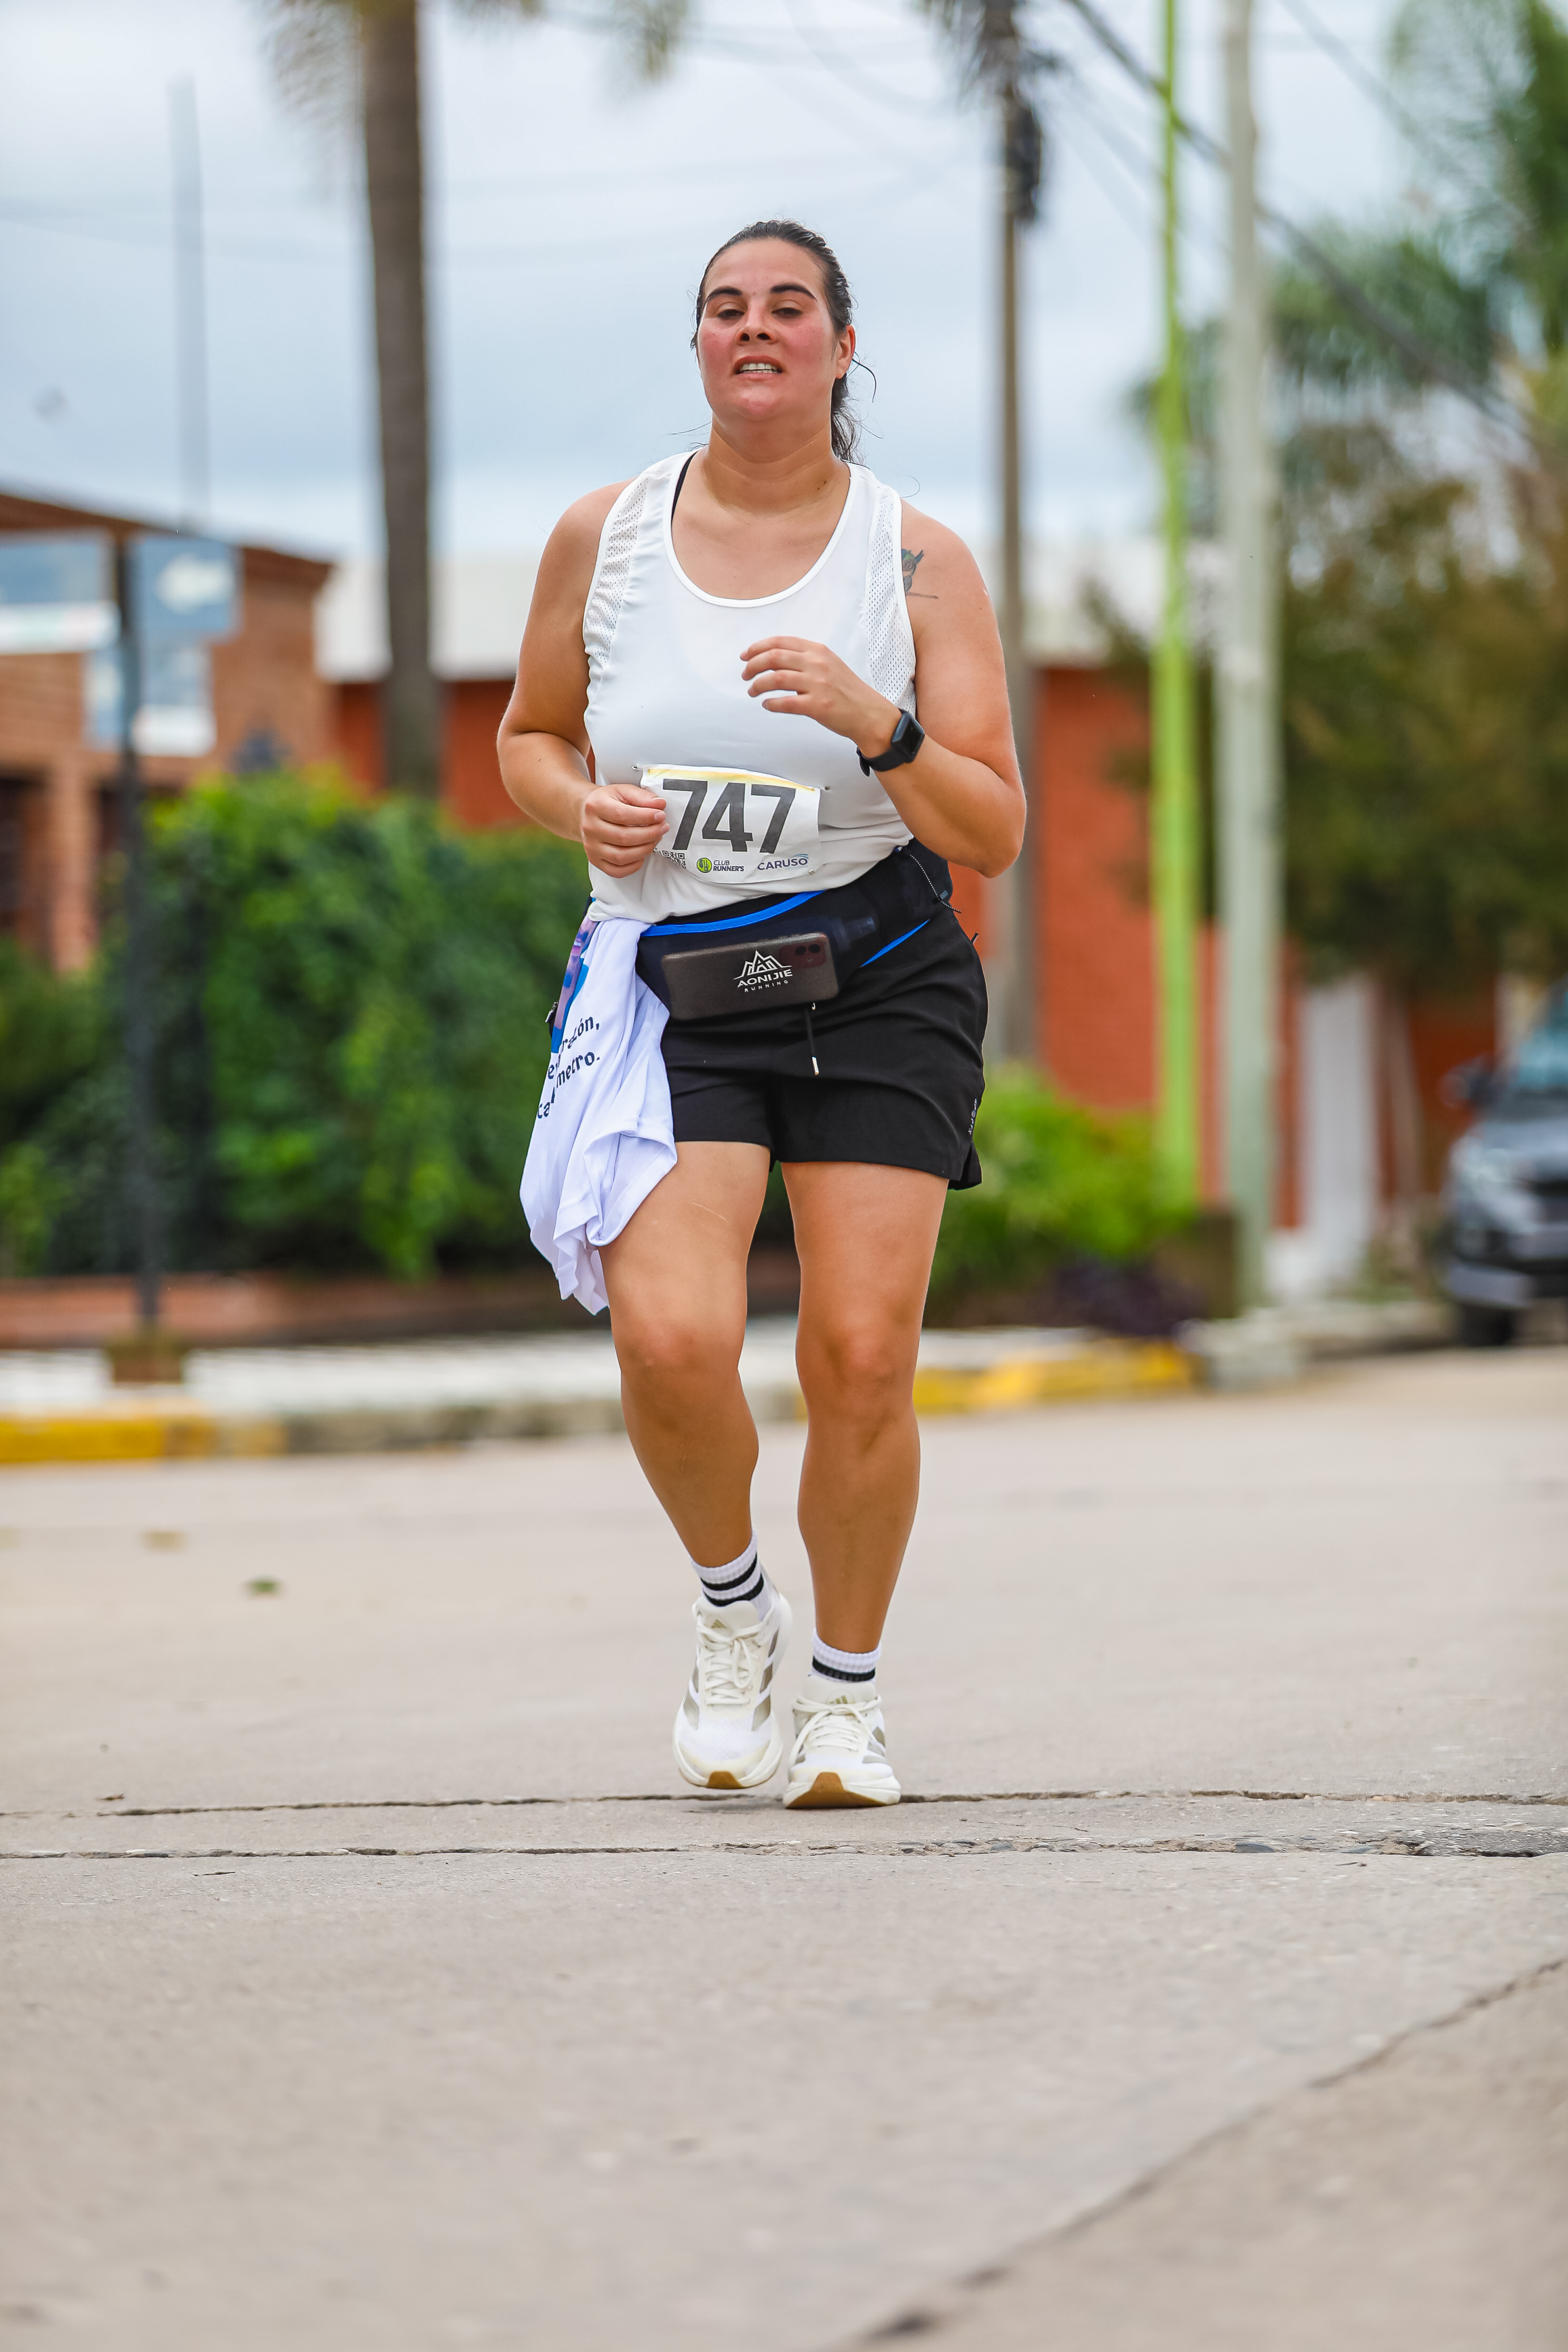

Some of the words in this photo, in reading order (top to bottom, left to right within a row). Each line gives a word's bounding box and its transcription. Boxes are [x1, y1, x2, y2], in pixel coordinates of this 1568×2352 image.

[662, 778, 796, 854] 747
[757, 858, 808, 870] CARUSO
[738, 969, 792, 987] AONIJIE
[744, 980, 788, 992] RUNNING
